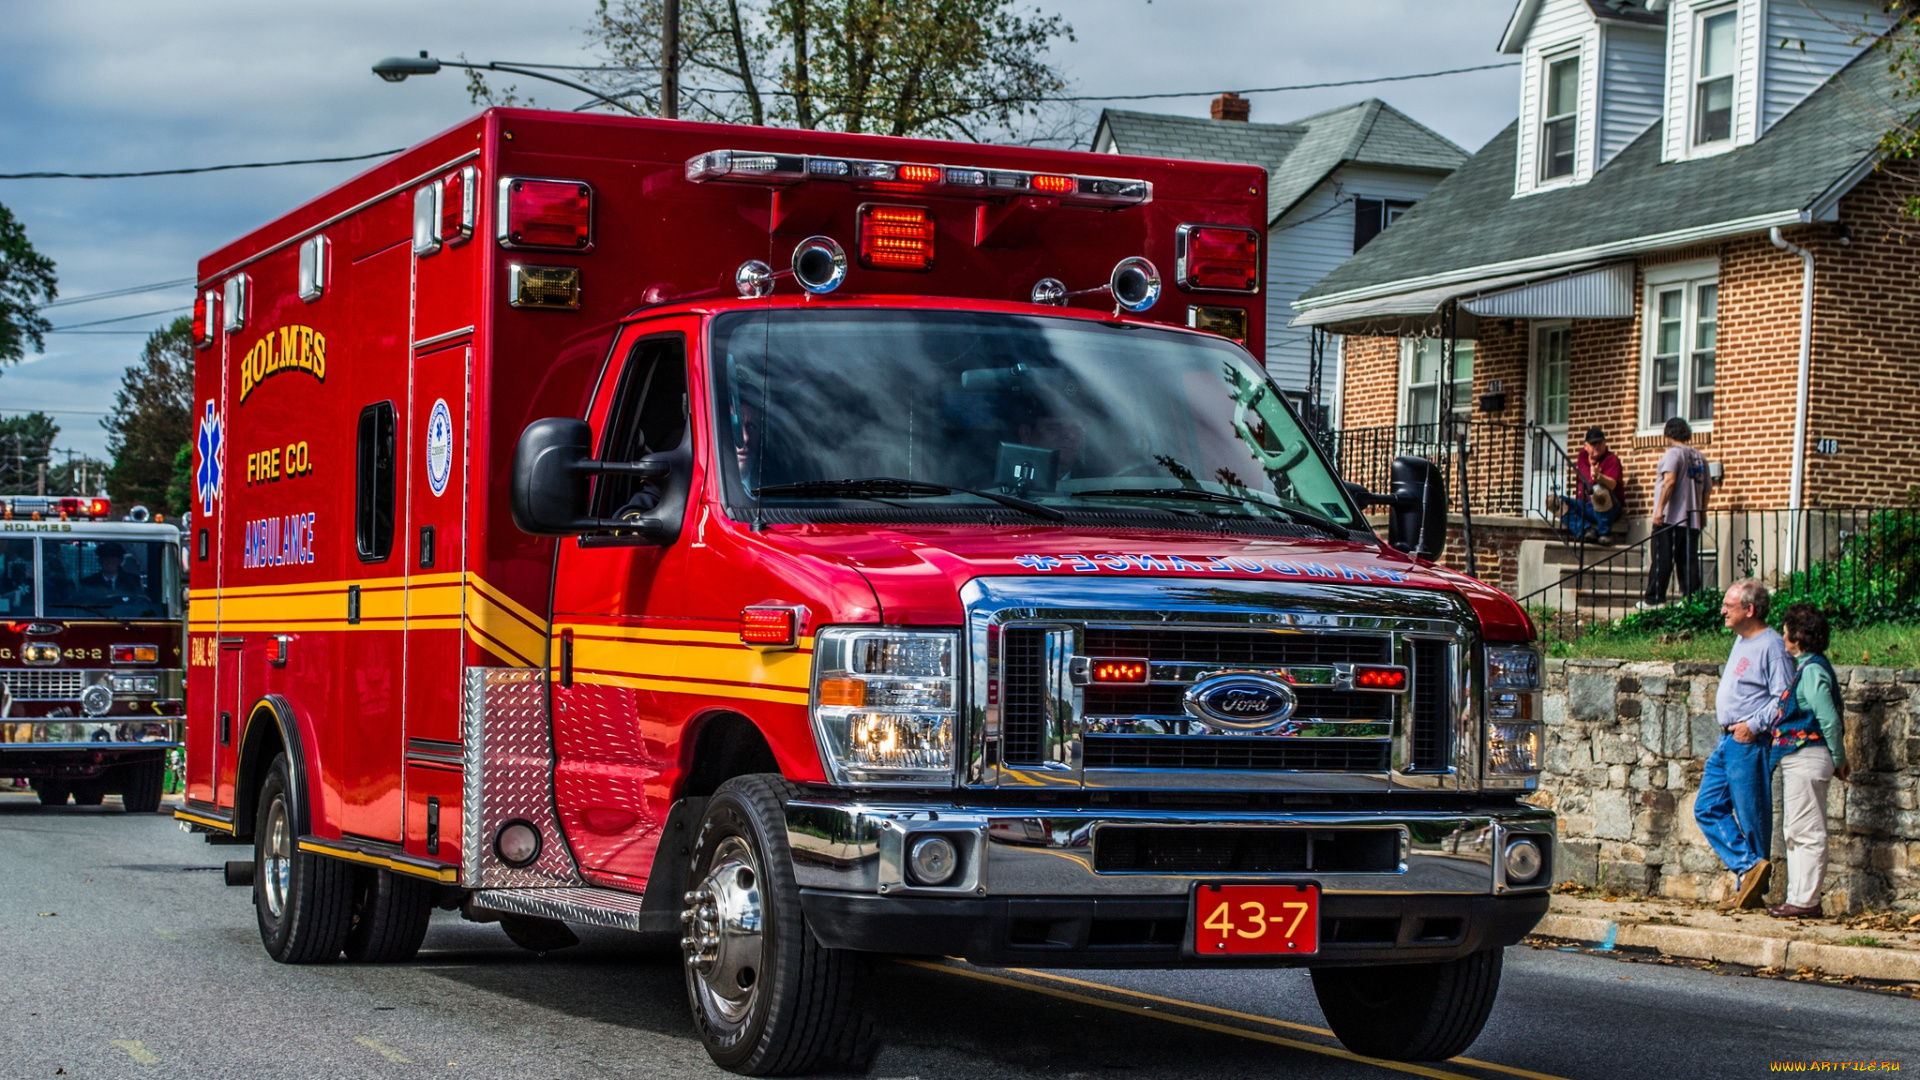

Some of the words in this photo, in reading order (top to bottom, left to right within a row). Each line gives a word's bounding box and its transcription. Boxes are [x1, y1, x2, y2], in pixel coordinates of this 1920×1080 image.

[240, 324, 326, 404] HOLMES
[247, 446, 281, 484] FIRE
[285, 441, 313, 477] CO.
[1817, 439, 1838, 454] 418
[4, 523, 72, 532] HOLMES
[243, 512, 315, 569] AMBULANCE
[191, 637, 206, 667] DIAL
[1222, 689, 1270, 711] Ford
[1203, 901, 1309, 939] 43-7
